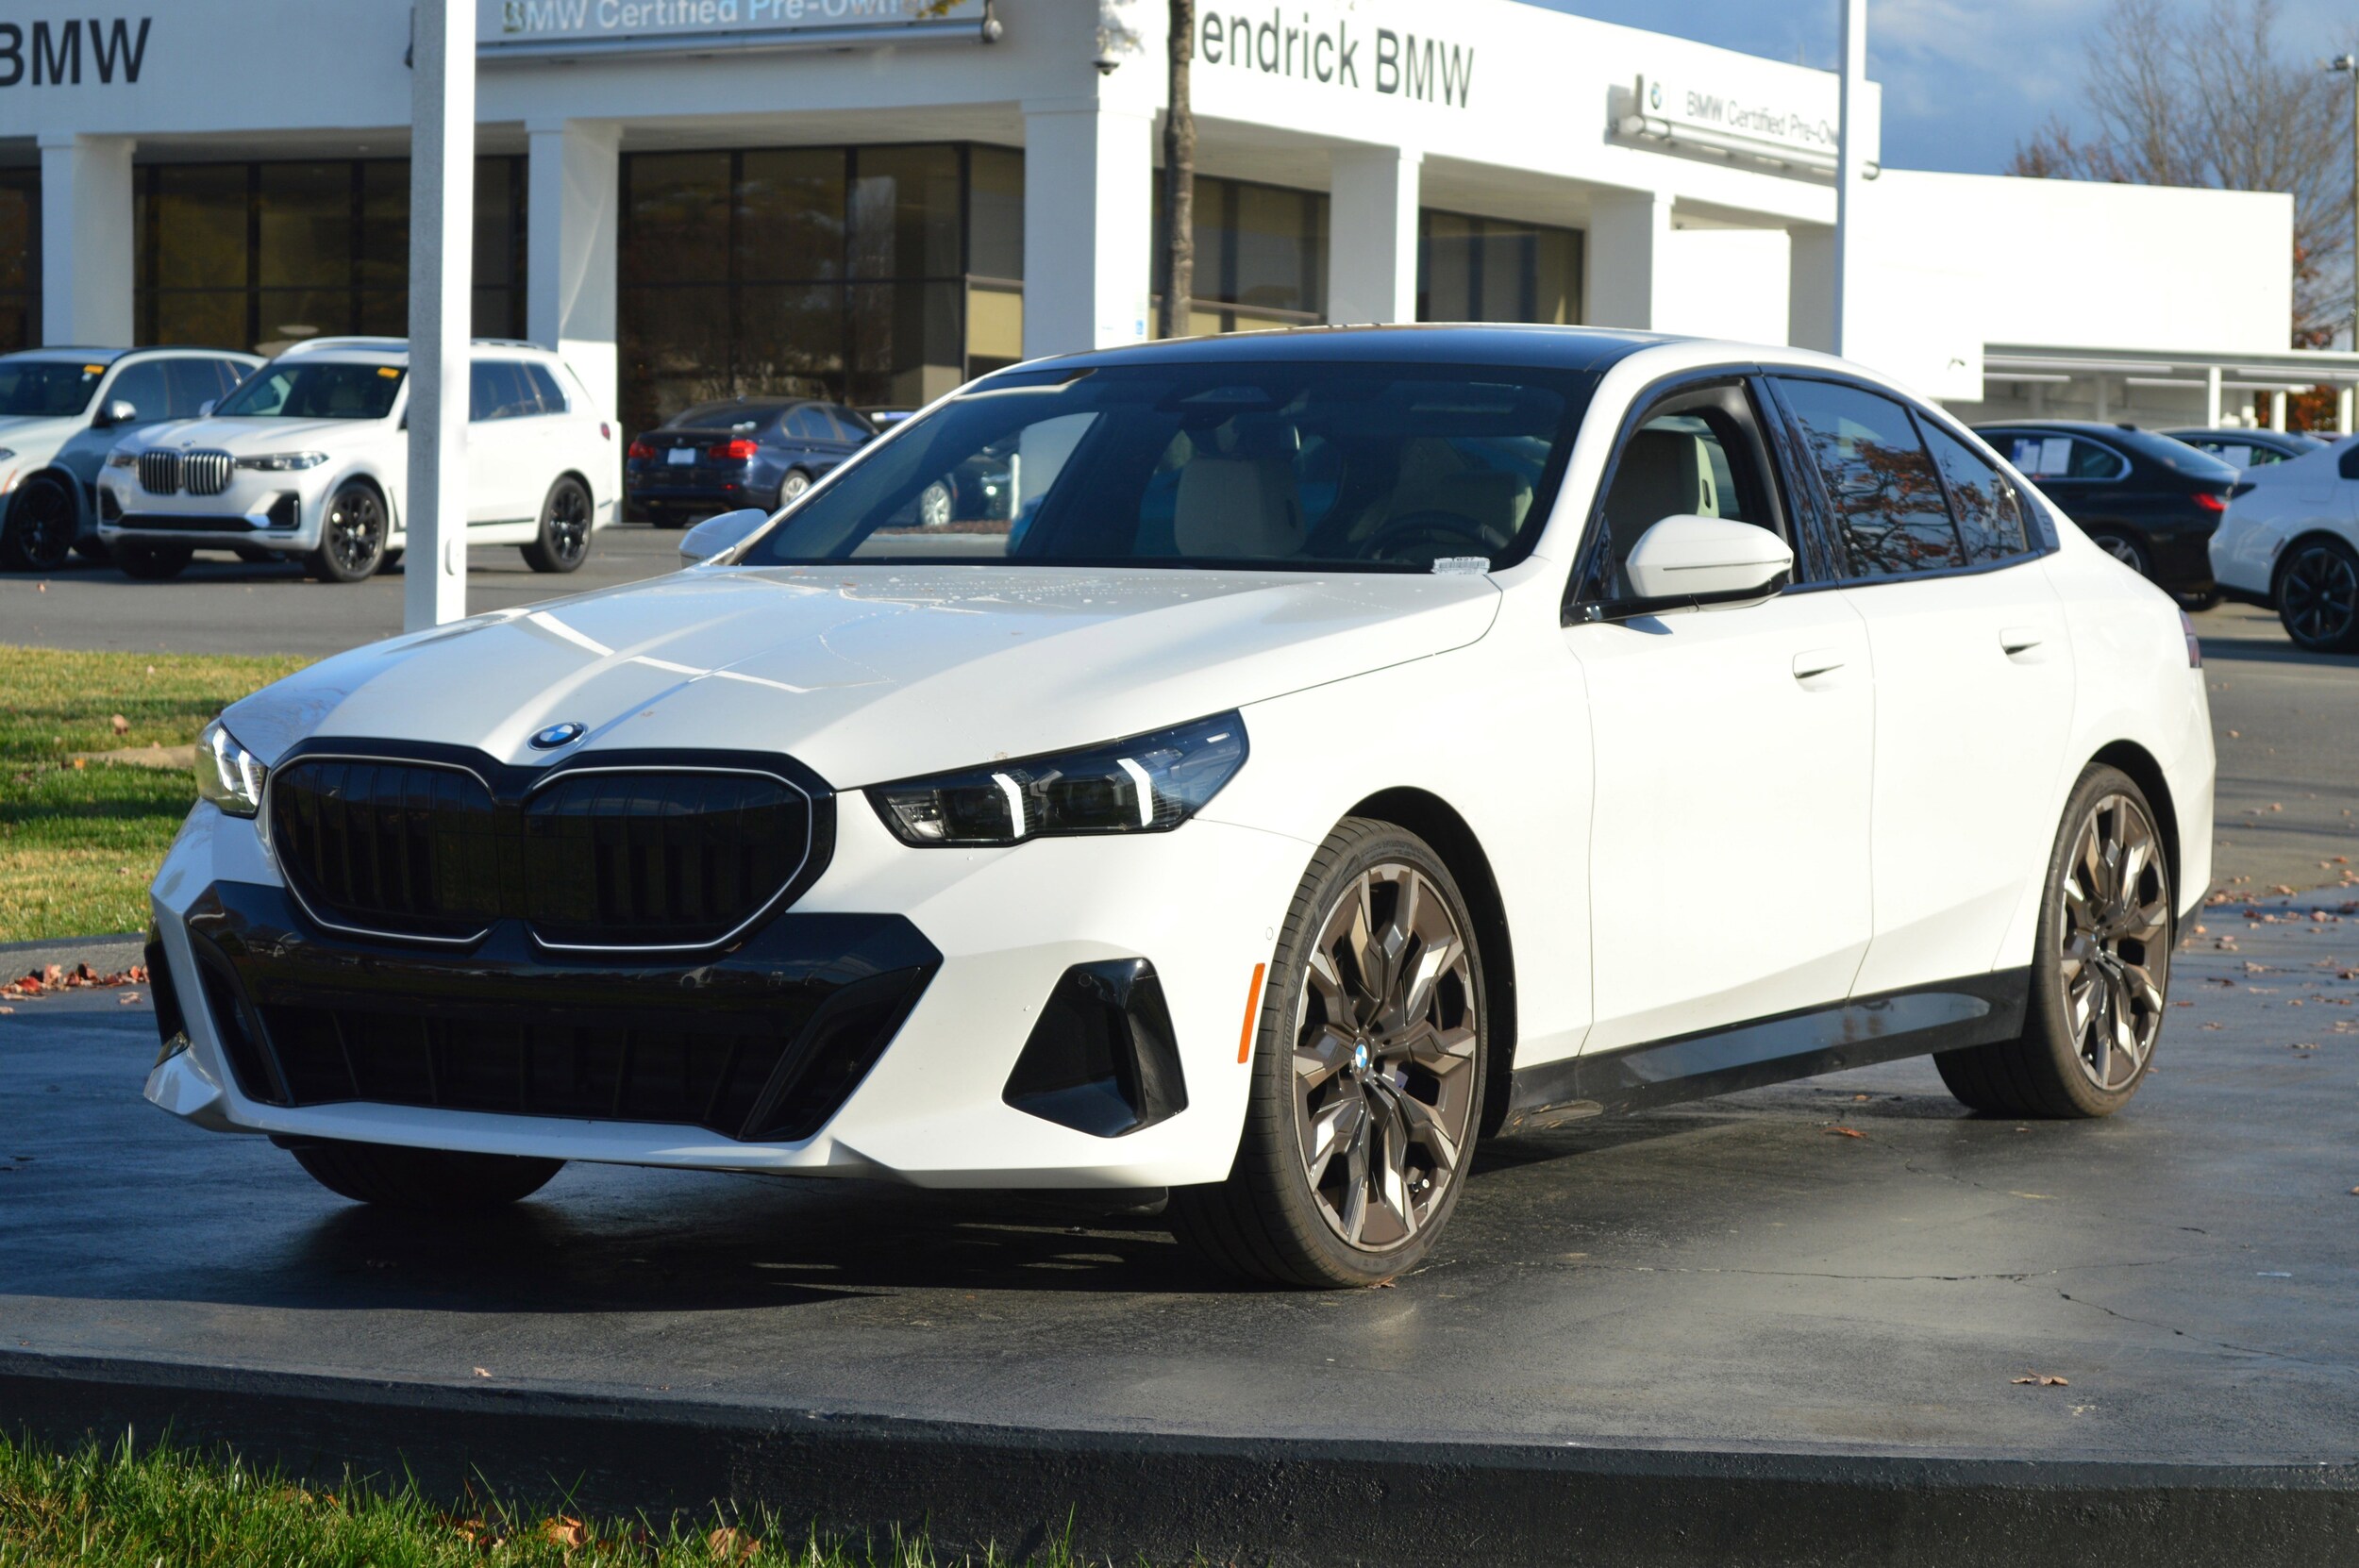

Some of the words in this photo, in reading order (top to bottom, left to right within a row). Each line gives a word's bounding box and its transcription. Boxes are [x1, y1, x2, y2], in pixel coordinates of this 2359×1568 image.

[503, 0, 588, 33] BMW
[598, 0, 738, 28] Certified
[1190, 4, 1359, 89] endrick
[1375, 27, 1474, 108] BMW
[1686, 90, 1723, 122] BMW
[1728, 100, 1785, 136] Certified
